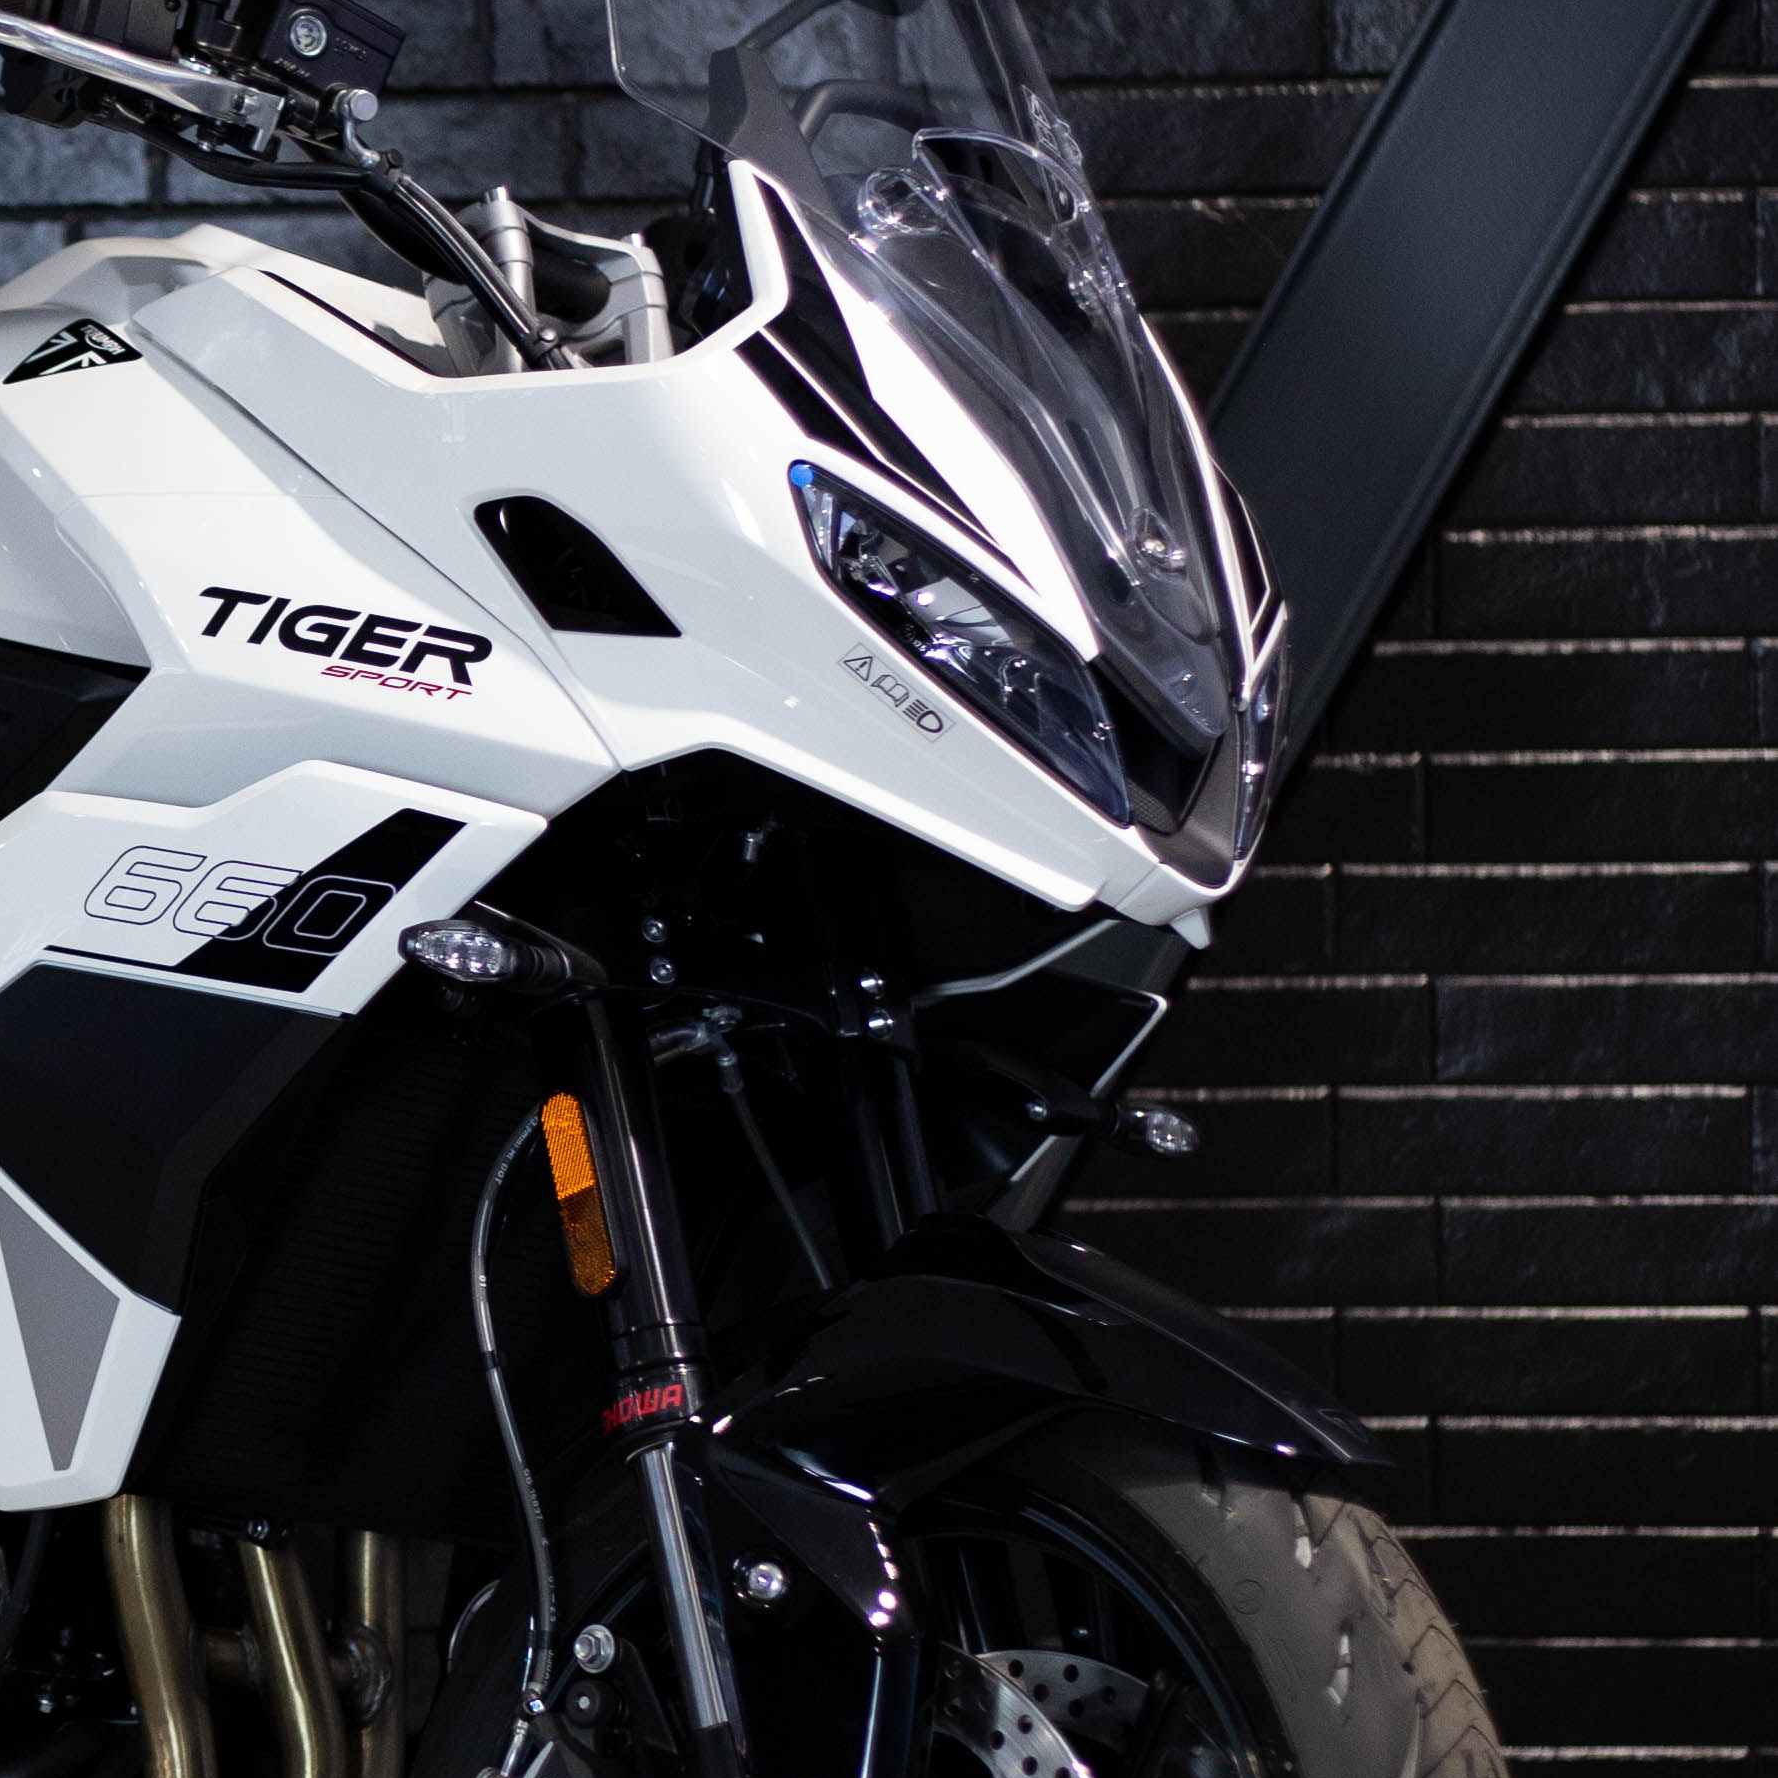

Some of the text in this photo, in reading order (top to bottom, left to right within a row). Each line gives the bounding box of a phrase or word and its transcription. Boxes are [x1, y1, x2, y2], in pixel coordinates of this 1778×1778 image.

[199, 586, 493, 687] TIGER
[320, 665, 473, 701] SPORT
[84, 845, 398, 957] 660
